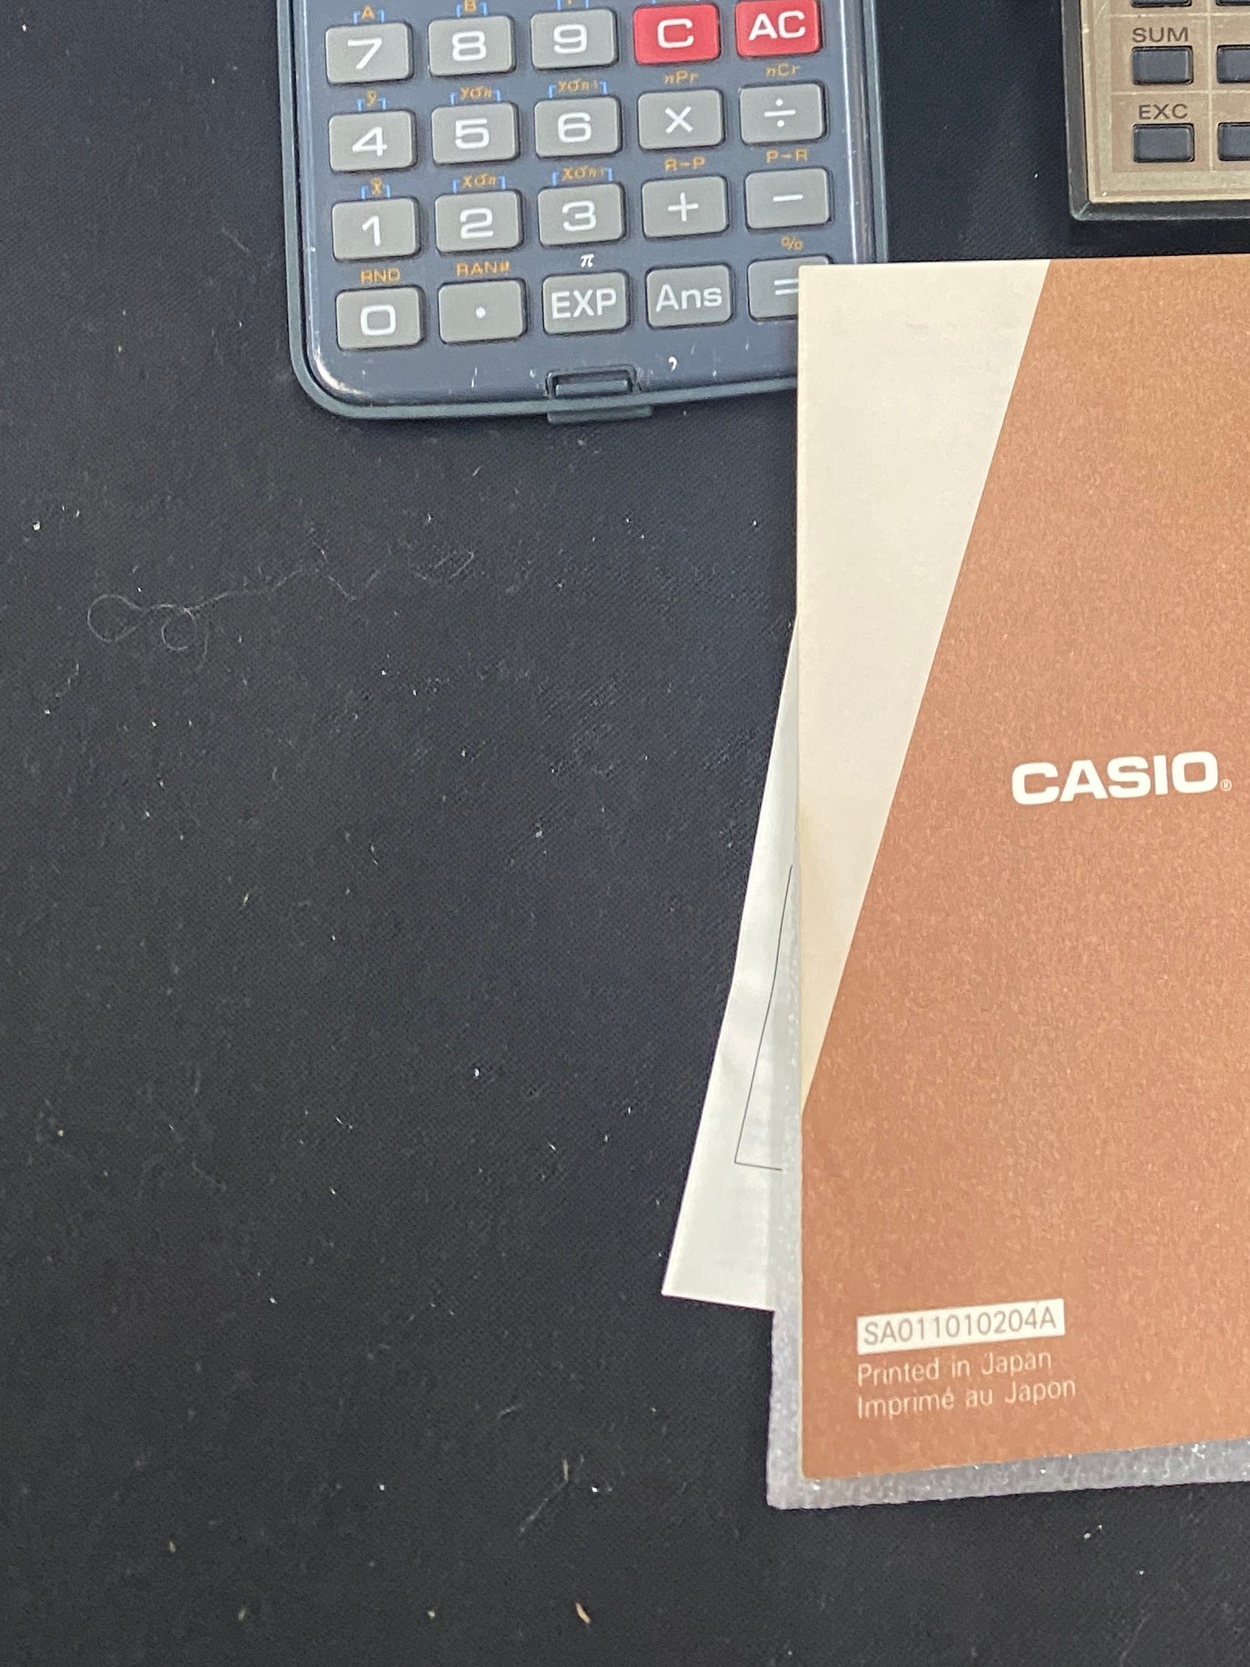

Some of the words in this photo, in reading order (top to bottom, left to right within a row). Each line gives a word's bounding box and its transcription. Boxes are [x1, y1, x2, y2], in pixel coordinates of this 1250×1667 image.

[553, 24, 588, 54] 9
[657, 18, 694, 48] C
[748, 10, 805, 41] AC
[1132, 26, 1189, 43] SUM
[348, 37, 383, 70] 7
[452, 31, 486, 62] 8
[558, 112, 592, 143] 6
[1138, 104, 1188, 120] EXC
[352, 126, 388, 157] 4
[455, 118, 489, 149] 5
[362, 215, 381, 246] 1
[459, 207, 494, 239] 2
[562, 200, 596, 232] 3
[360, 268, 400, 283] RND
[551, 287, 617, 320] EXP
[655, 284, 722, 313] Ans
[360, 304, 396, 336] 0
[1011, 750, 1218, 806] CASIO
[863, 1306, 1057, 1346] SA011010204A
[857, 1357, 940, 1387] Printed
[951, 1357, 970, 1378] in
[981, 1351, 1052, 1377] Japan
[857, 1386, 955, 1419] Imprimé
[965, 1388, 993, 1408] au
[1005, 1379, 1076, 1405] Japon
